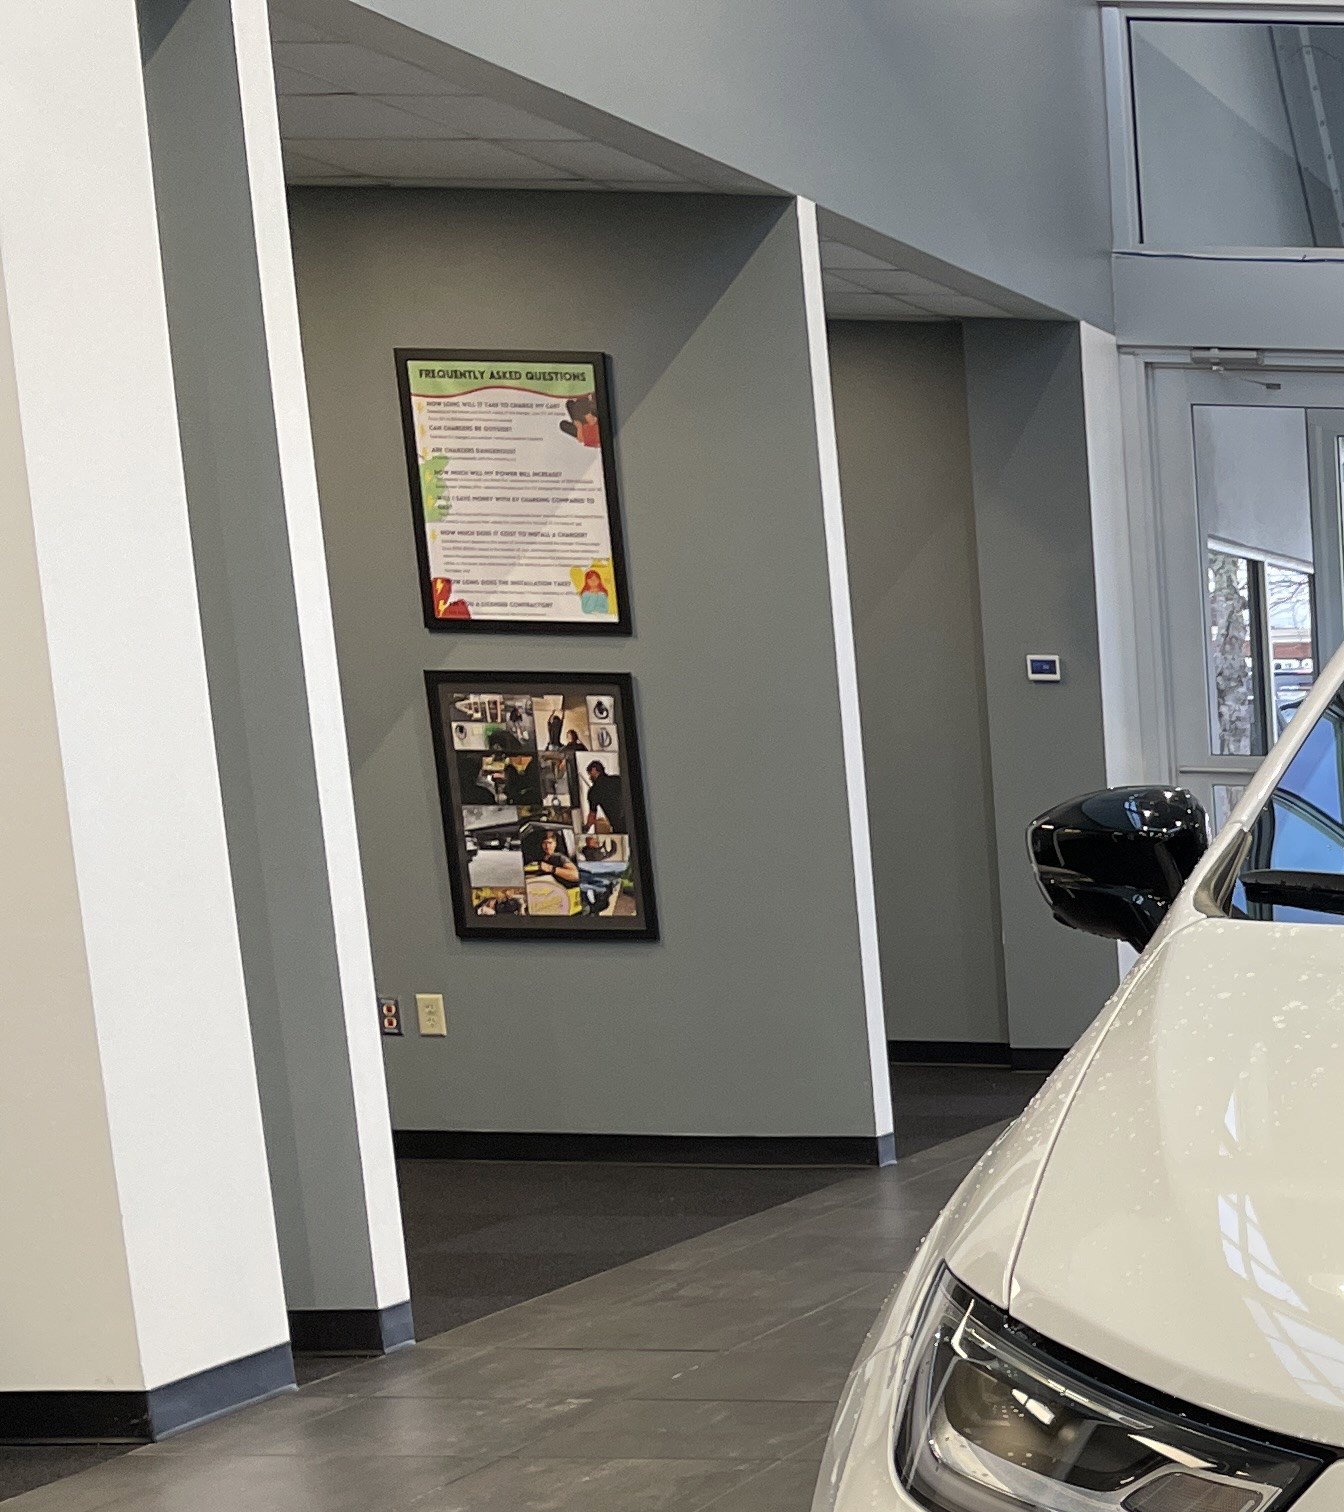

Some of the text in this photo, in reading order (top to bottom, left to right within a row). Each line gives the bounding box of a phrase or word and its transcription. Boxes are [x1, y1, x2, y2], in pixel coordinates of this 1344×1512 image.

[418, 368, 587, 382] FREQUENTLY ASKED QUESTIONS
